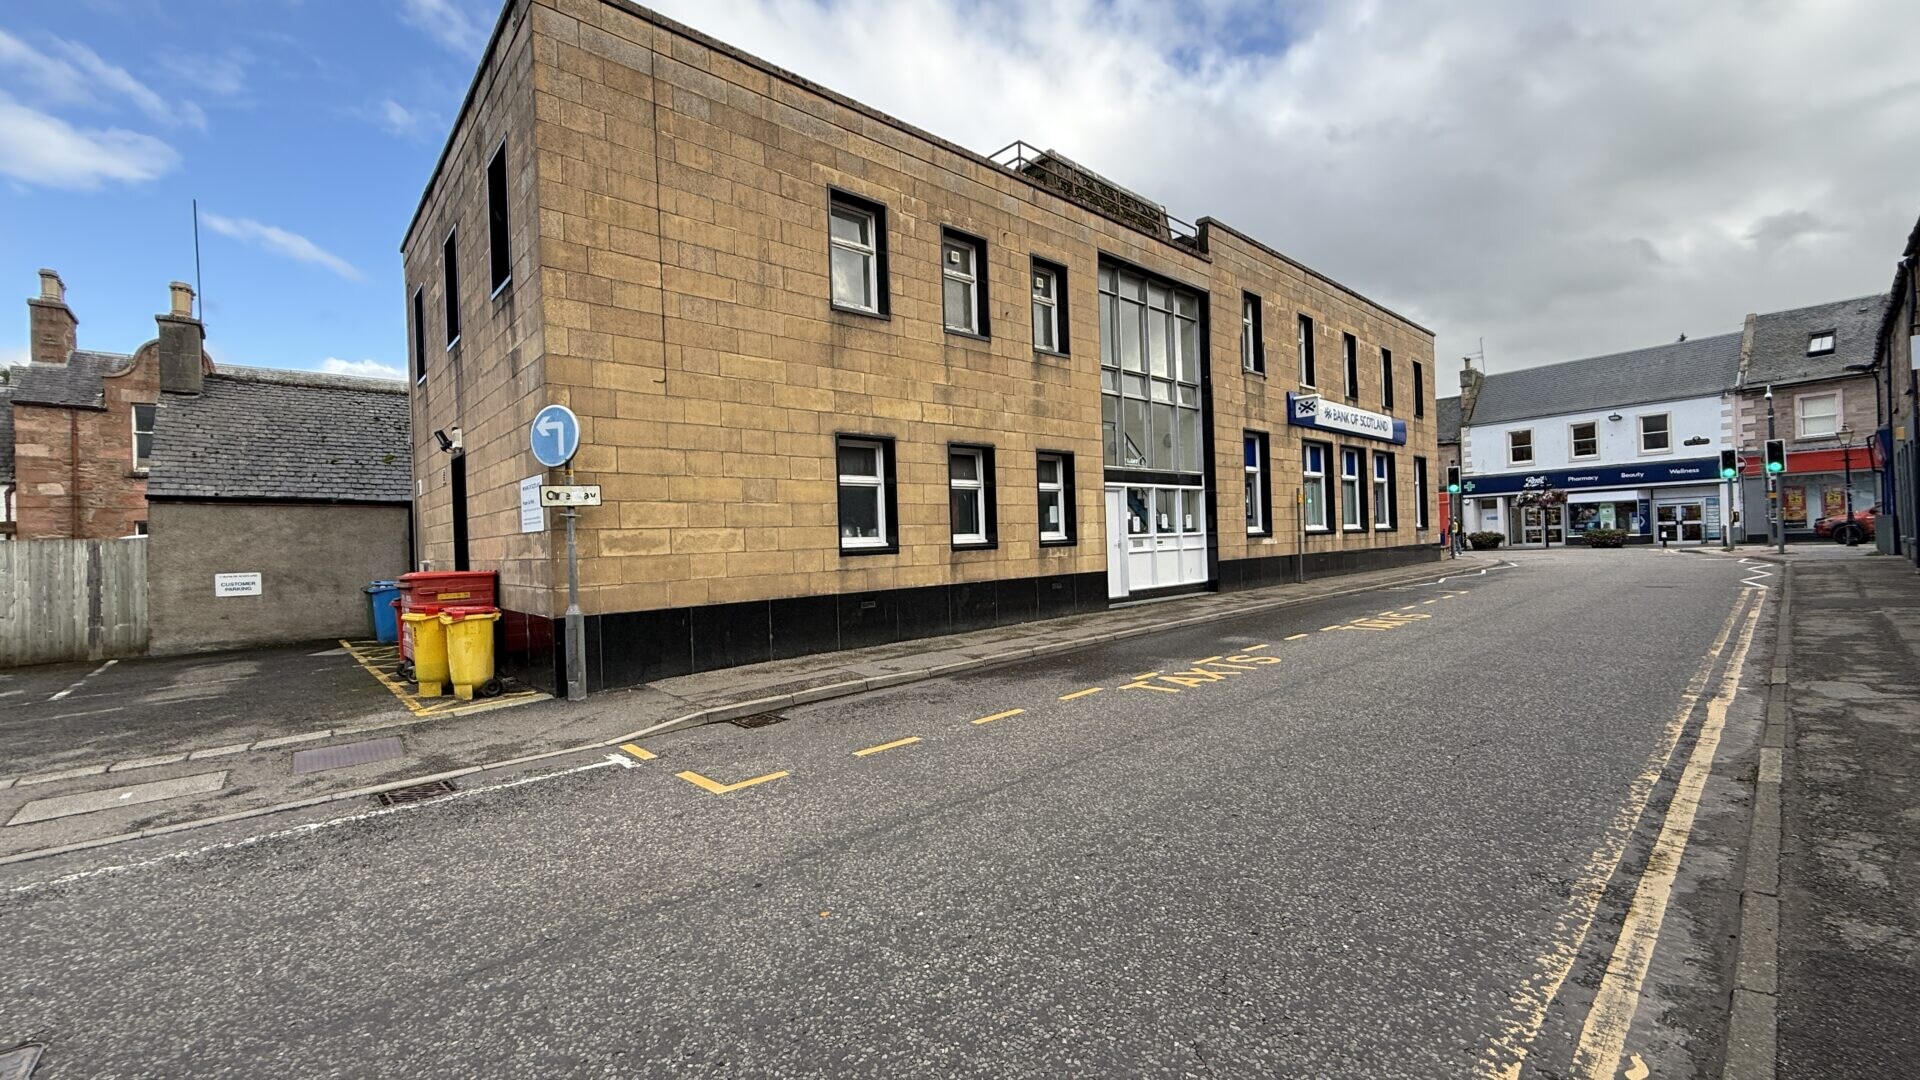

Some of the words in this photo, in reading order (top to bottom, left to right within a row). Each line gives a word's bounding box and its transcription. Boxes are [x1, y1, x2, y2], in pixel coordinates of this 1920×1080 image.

[1333, 409, 1350, 424] BANK
[1350, 413, 1359, 425] OF
[1360, 415, 1389, 432] SCOTLAND
[1669, 467, 1700, 475] Wellness
[1118, 654, 1282, 693] TAXIS
